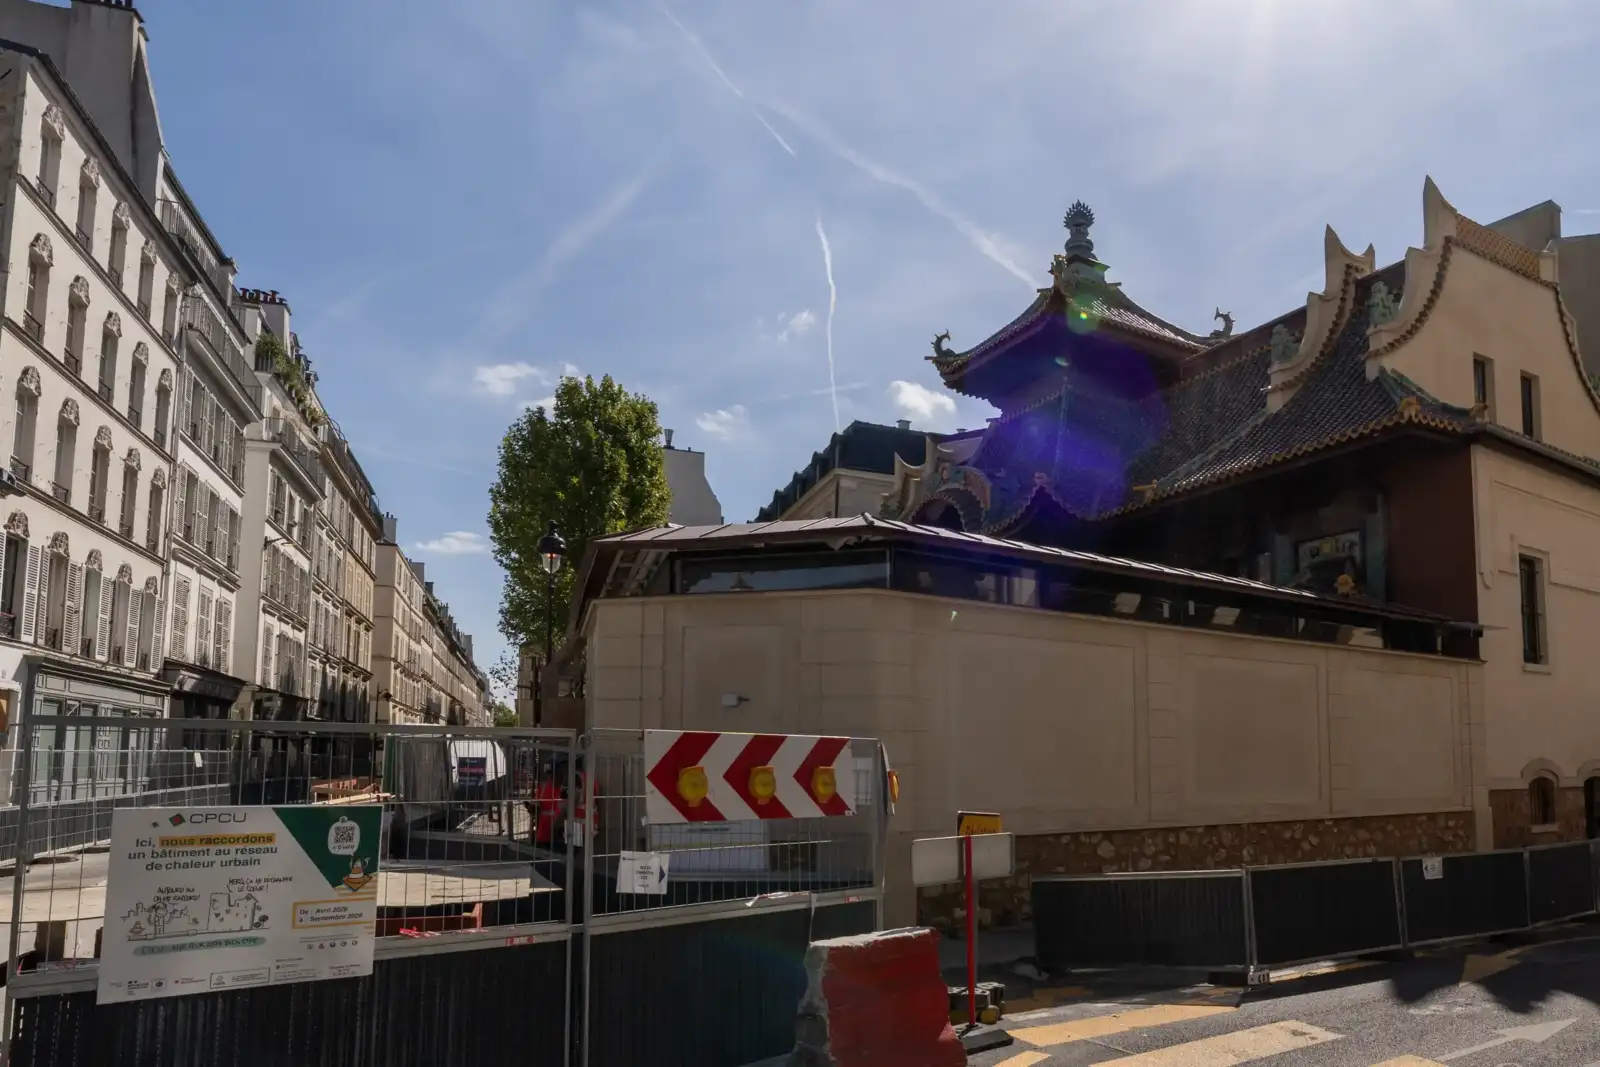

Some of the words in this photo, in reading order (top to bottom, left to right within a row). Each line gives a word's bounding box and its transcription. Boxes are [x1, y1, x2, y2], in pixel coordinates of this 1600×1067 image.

[189, 813, 247, 824] CPCU
[135, 838, 156, 848] Ici,
[160, 837, 196, 847] nous
[199, 833, 273, 845] raccordons
[128, 851, 146, 860] un
[151, 847, 211, 859] bâtiment
[214, 848, 231, 856] au
[235, 846, 278, 855] réseau
[145, 862, 162, 871] de
[165, 860, 216, 871] chaleur
[220, 857, 261, 867] urbain
[310, 914, 346, 923] Septembre
